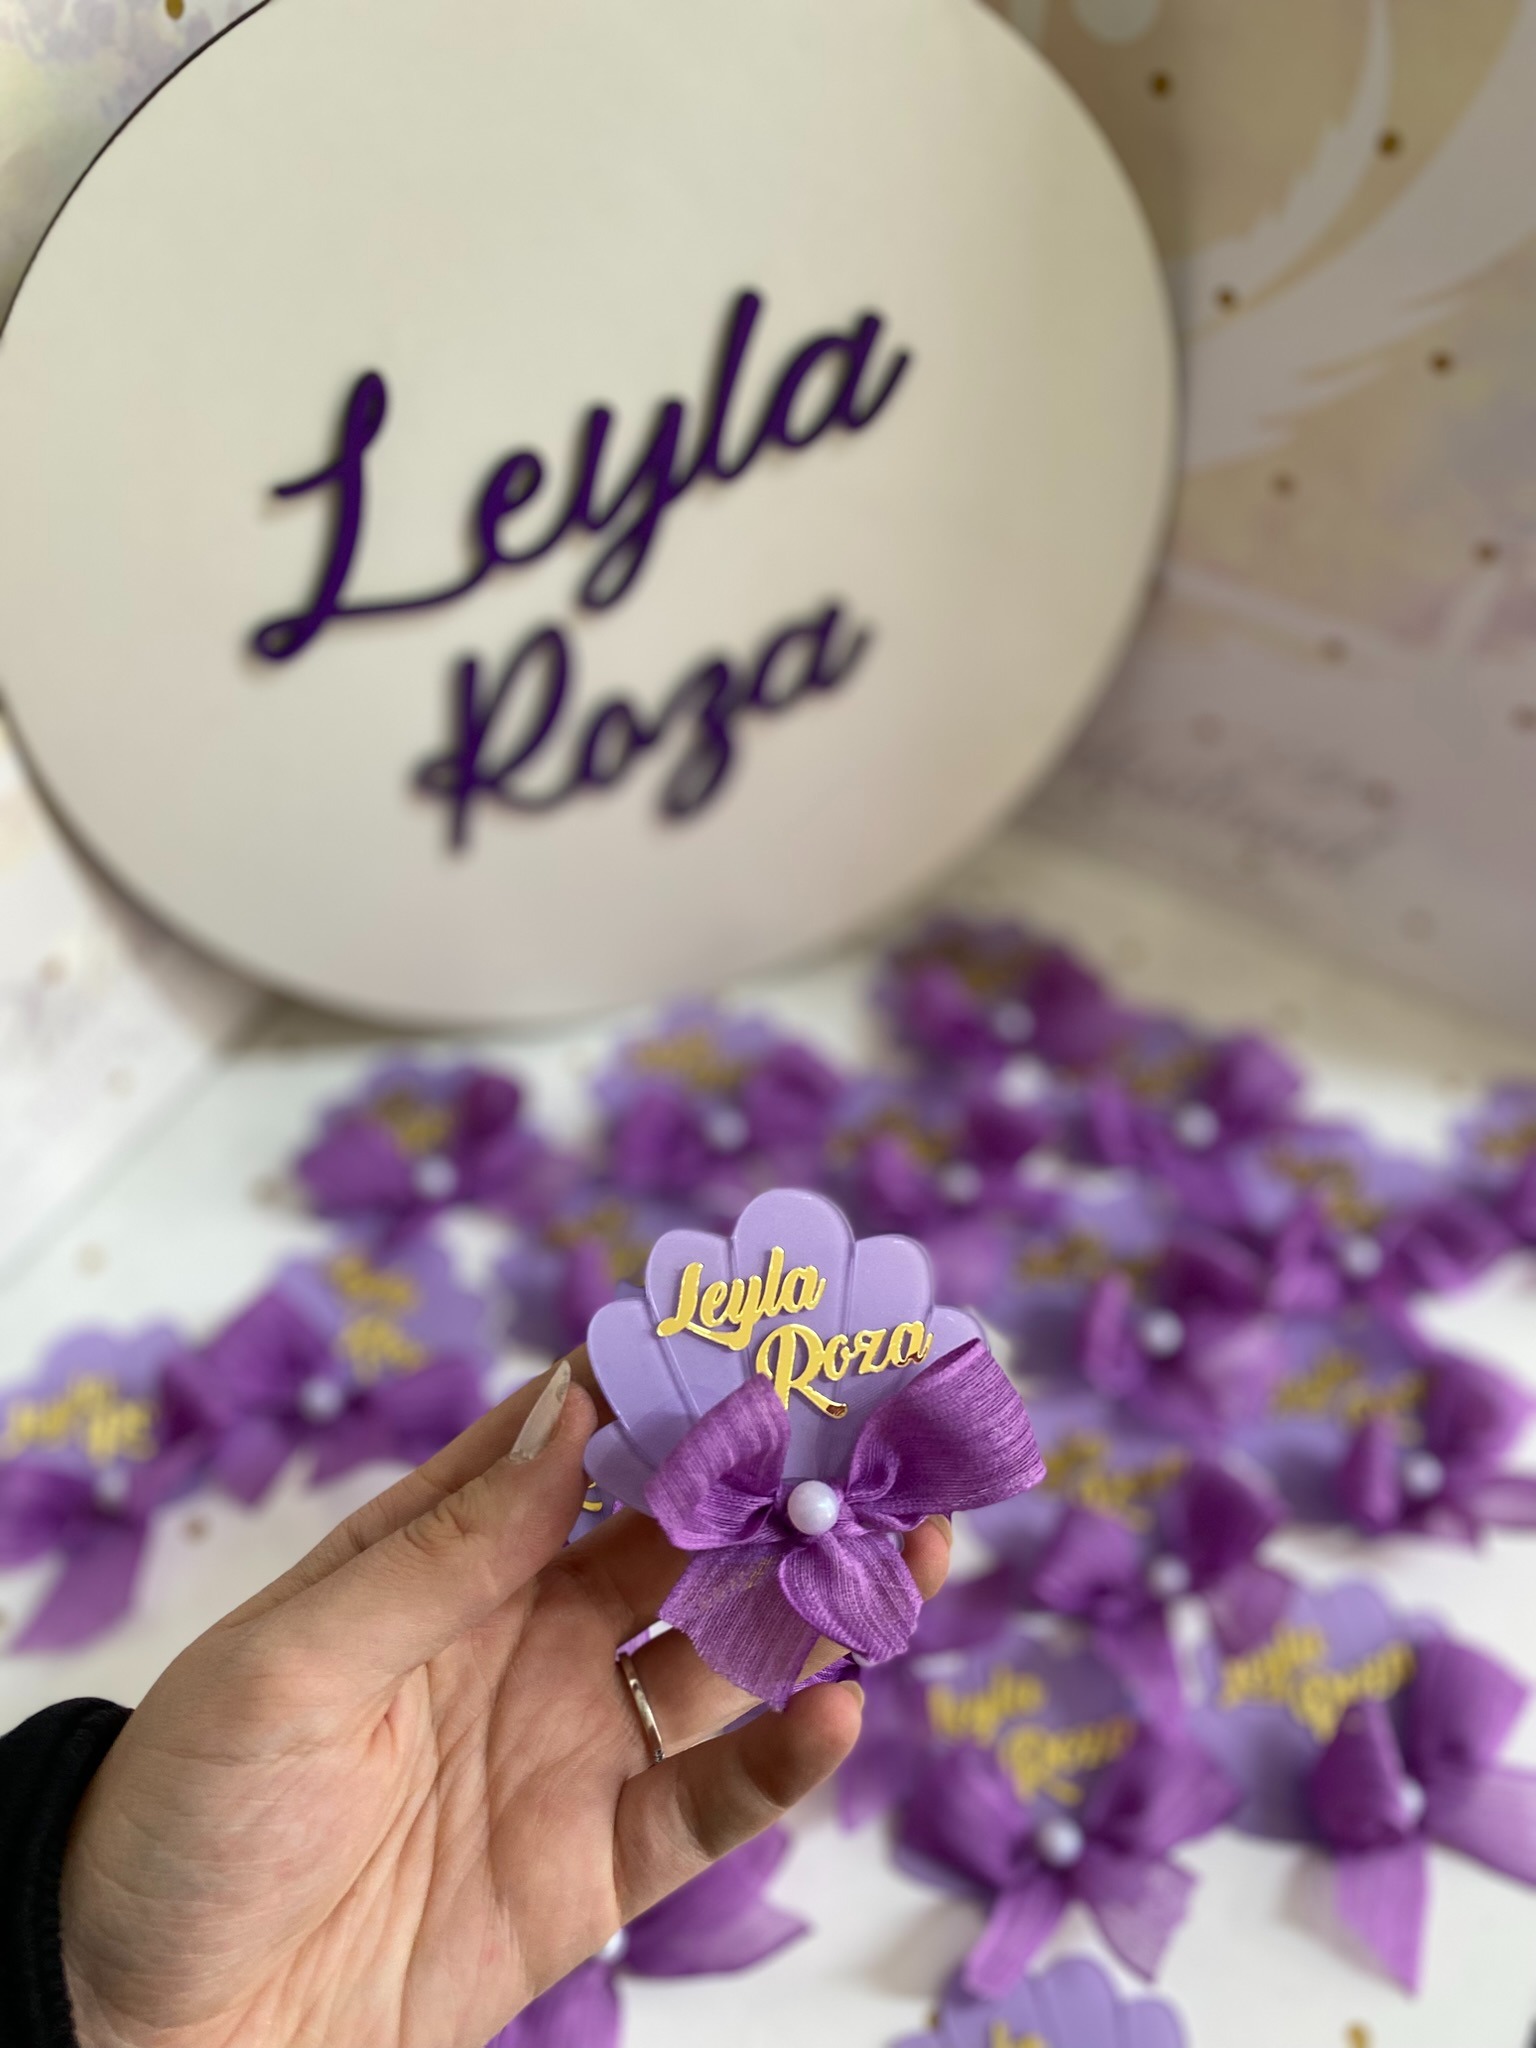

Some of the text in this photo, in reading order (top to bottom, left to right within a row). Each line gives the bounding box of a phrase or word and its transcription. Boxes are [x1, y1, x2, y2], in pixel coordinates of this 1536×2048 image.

[248, 286, 911, 660] Leyla
[411, 602, 876, 856] Roza
[656, 1246, 827, 1351] Leyla
[755, 1323, 934, 1419] Roza
